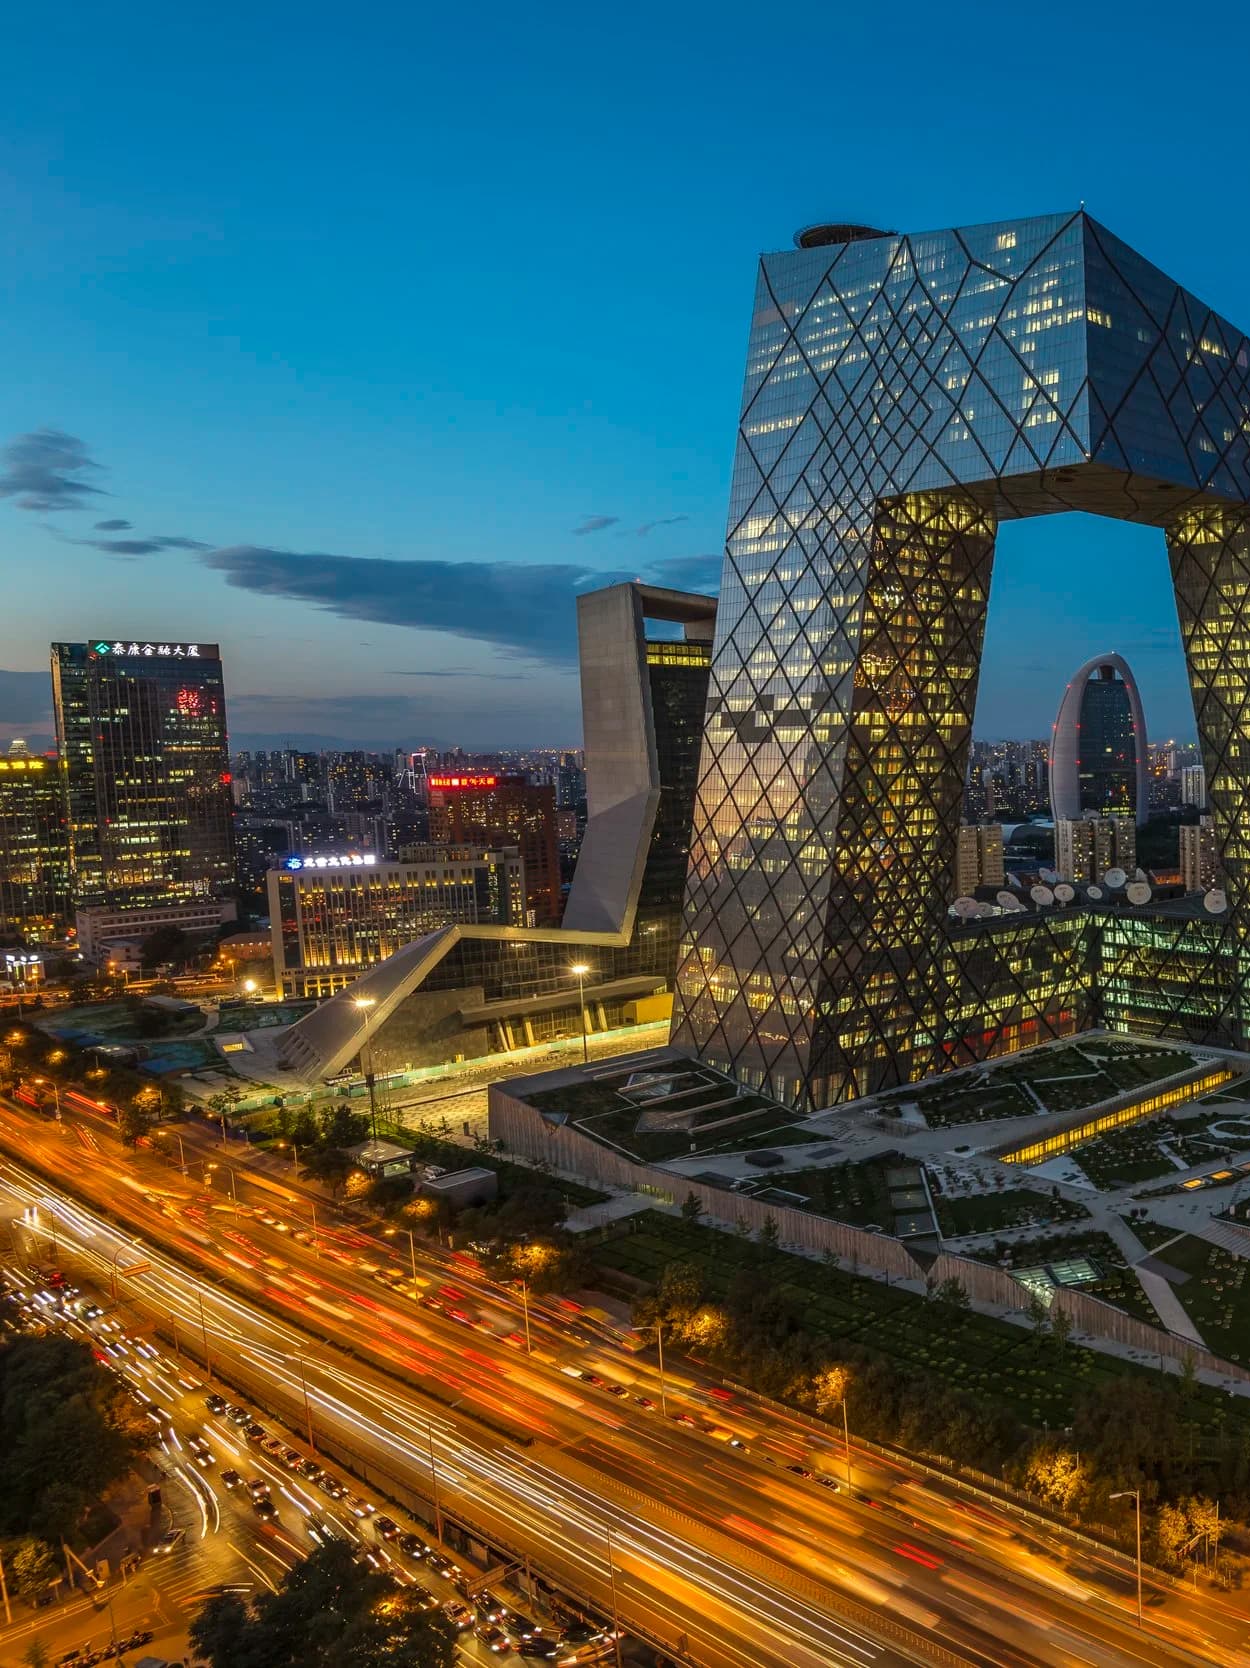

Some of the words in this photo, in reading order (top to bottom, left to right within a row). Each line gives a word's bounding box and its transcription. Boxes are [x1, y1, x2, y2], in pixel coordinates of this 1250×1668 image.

[111, 642, 200, 657] 泰康金融大厦
